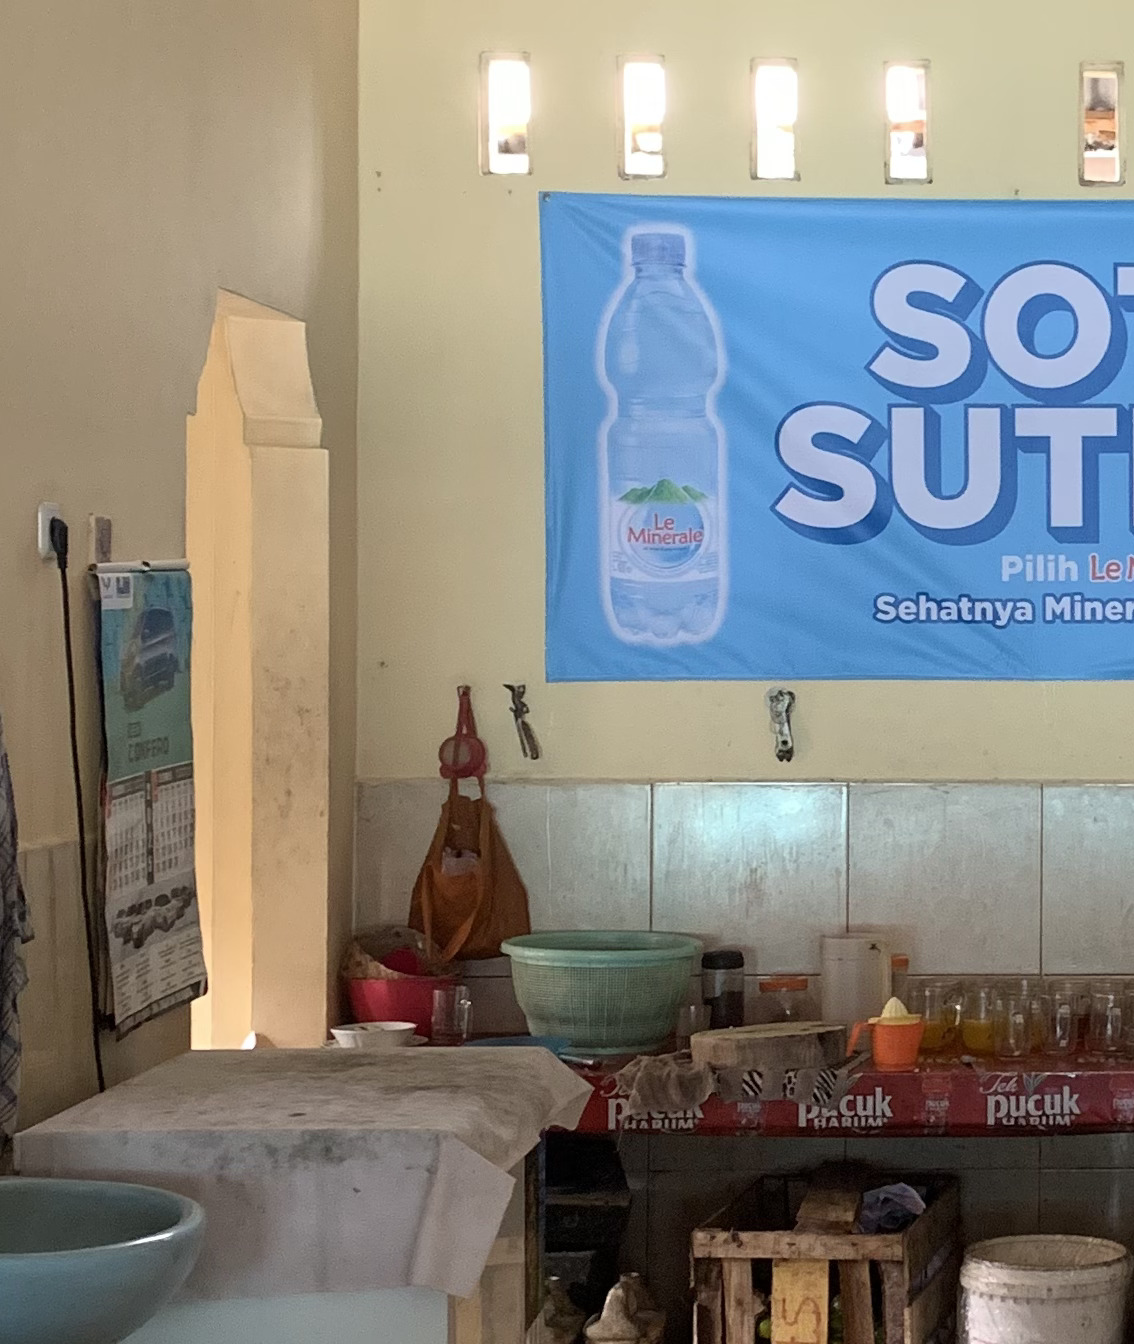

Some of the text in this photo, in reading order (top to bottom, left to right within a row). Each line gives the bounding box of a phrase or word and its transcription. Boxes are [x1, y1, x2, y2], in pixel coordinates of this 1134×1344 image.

[626, 527, 704, 545] Minerale
[654, 513, 675, 531] Le
[1001, 555, 1078, 582] Pilih
[1090, 554, 1121, 582] Le
[875, 594, 1033, 625] Sehatnya
[986, 1085, 1082, 1126] pucuk
